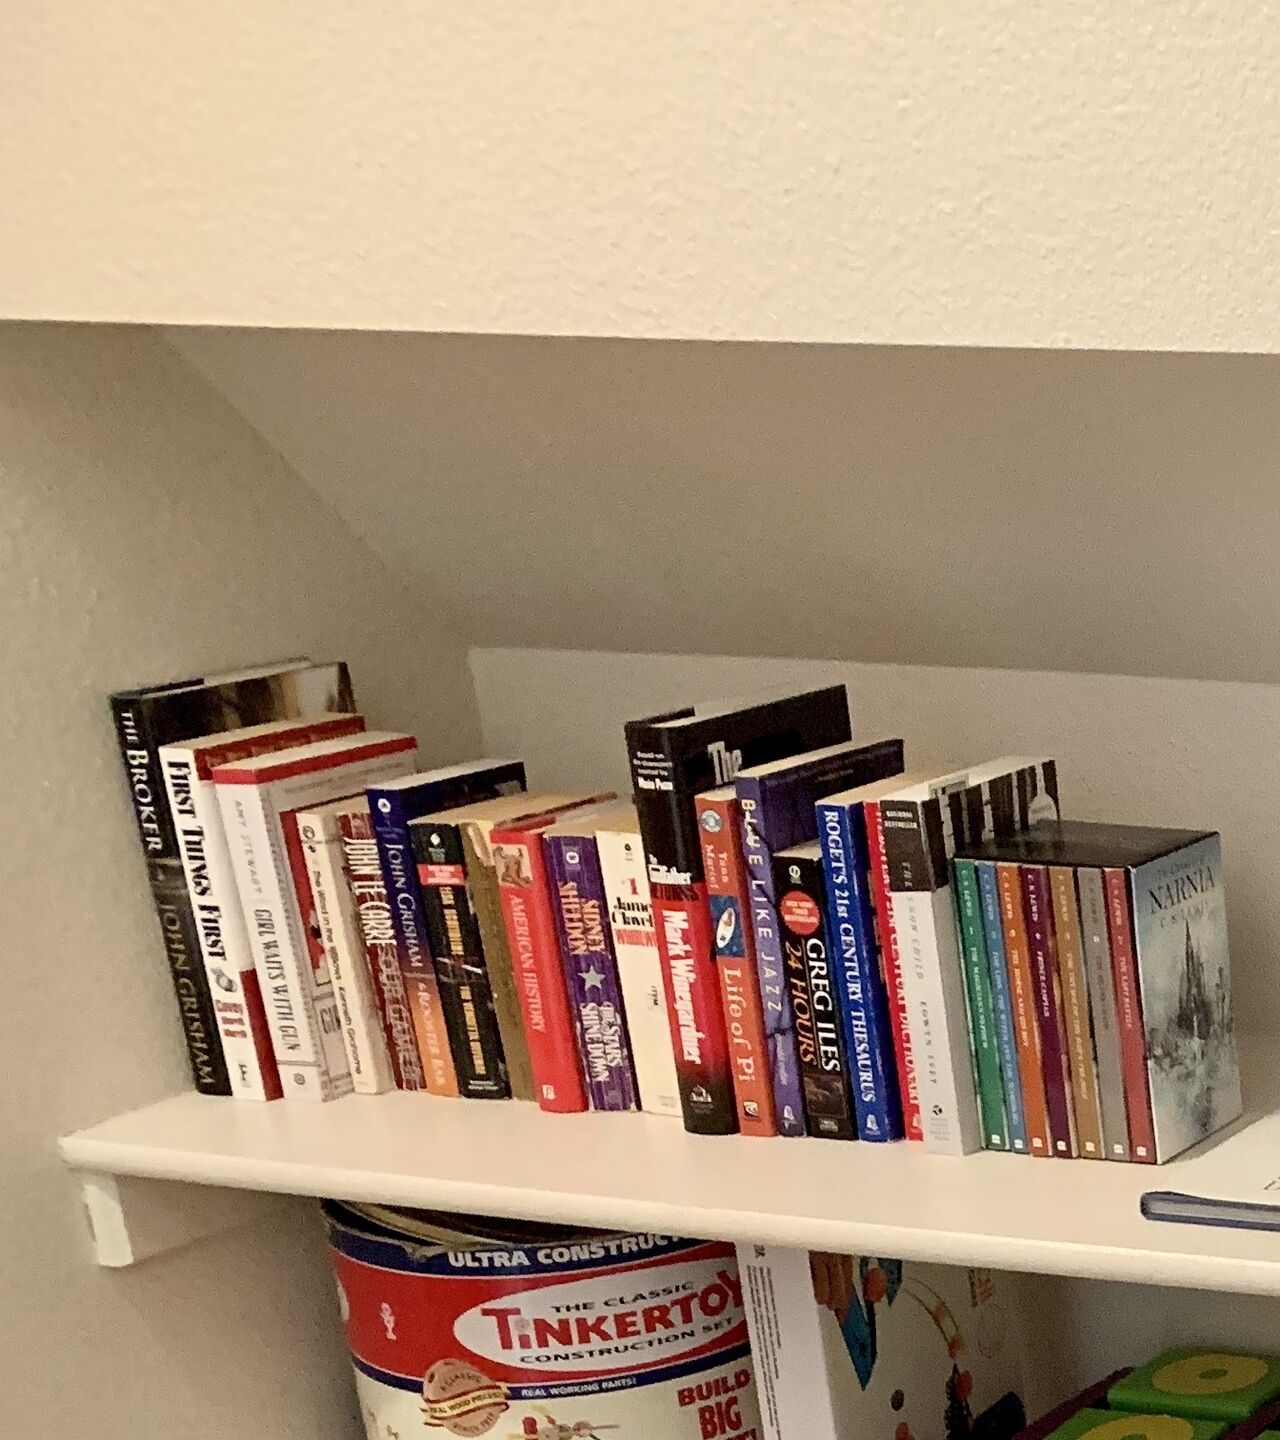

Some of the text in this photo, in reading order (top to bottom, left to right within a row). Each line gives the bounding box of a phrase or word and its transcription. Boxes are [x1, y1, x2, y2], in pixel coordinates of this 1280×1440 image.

[121, 710, 162, 850] THE BROKER
[708, 741, 742, 785] The
[168, 761, 226, 961] FIRST THINGS FIRST
[344, 837, 383, 875] JOHN
[353, 880, 387, 896] LE
[386, 843, 423, 967] JOHN GRISHAM
[751, 879, 773, 938] LIKE
[1147, 865, 1215, 915] NARNIA
[558, 881, 586, 955] SHELDON
[581, 898, 606, 951] SIDNEY
[254, 909, 301, 1051] GIRL WAITS WITH GUN
[509, 894, 546, 1033] AMERICAN HISTORY
[761, 952, 782, 1012] JAZZ
[786, 941, 803, 970] 24
[824, 811, 875, 1103] ROGET'S 21st CENTURY THESAURUS
[159, 903, 216, 1083] JOHN GRISHAM
[662, 910, 704, 1064] Mark Winegardner
[806, 938, 841, 1072] GREG ILES
[724, 967, 759, 1082] Life of Pi
[790, 979, 817, 1066] HOURS
[448, 1250, 531, 1268] ULTRA
[551, 1281, 694, 1313] THE CLASSIC
[520, 1316, 733, 1364] CONSTRUCTION SET
[522, 1388, 547, 1398] REAL
[550, 1380, 599, 1395] WORKING
[677, 1368, 751, 1408] BUILD
[699, 1400, 744, 1440] BIG
